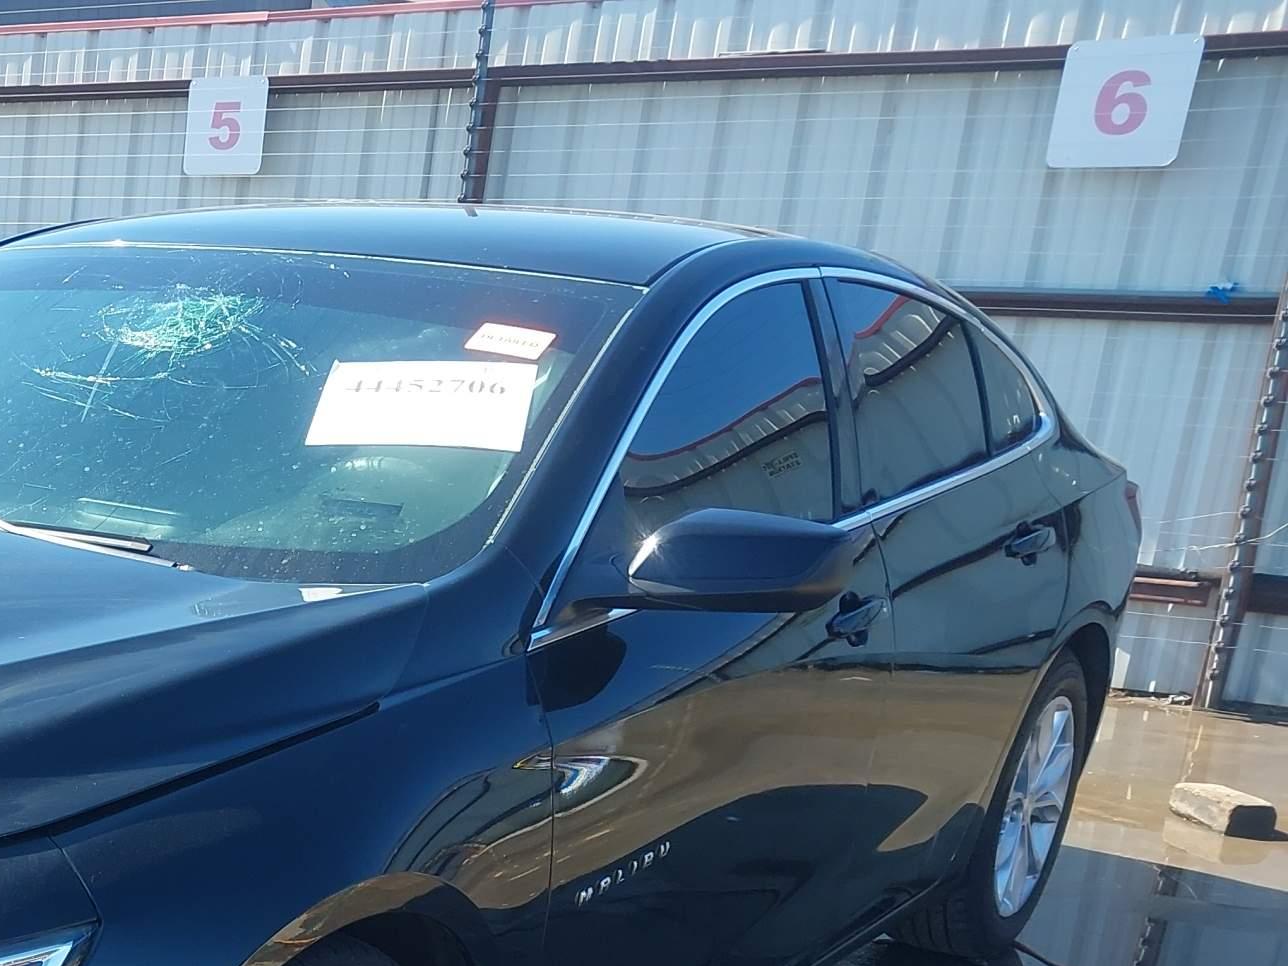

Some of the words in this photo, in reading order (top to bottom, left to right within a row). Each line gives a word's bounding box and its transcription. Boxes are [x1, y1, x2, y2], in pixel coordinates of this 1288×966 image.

[208, 101, 241, 151] 5
[1094, 69, 1152, 136] 6
[344, 378, 507, 395] 44452706
[575, 841, 671, 907] MALIBU
